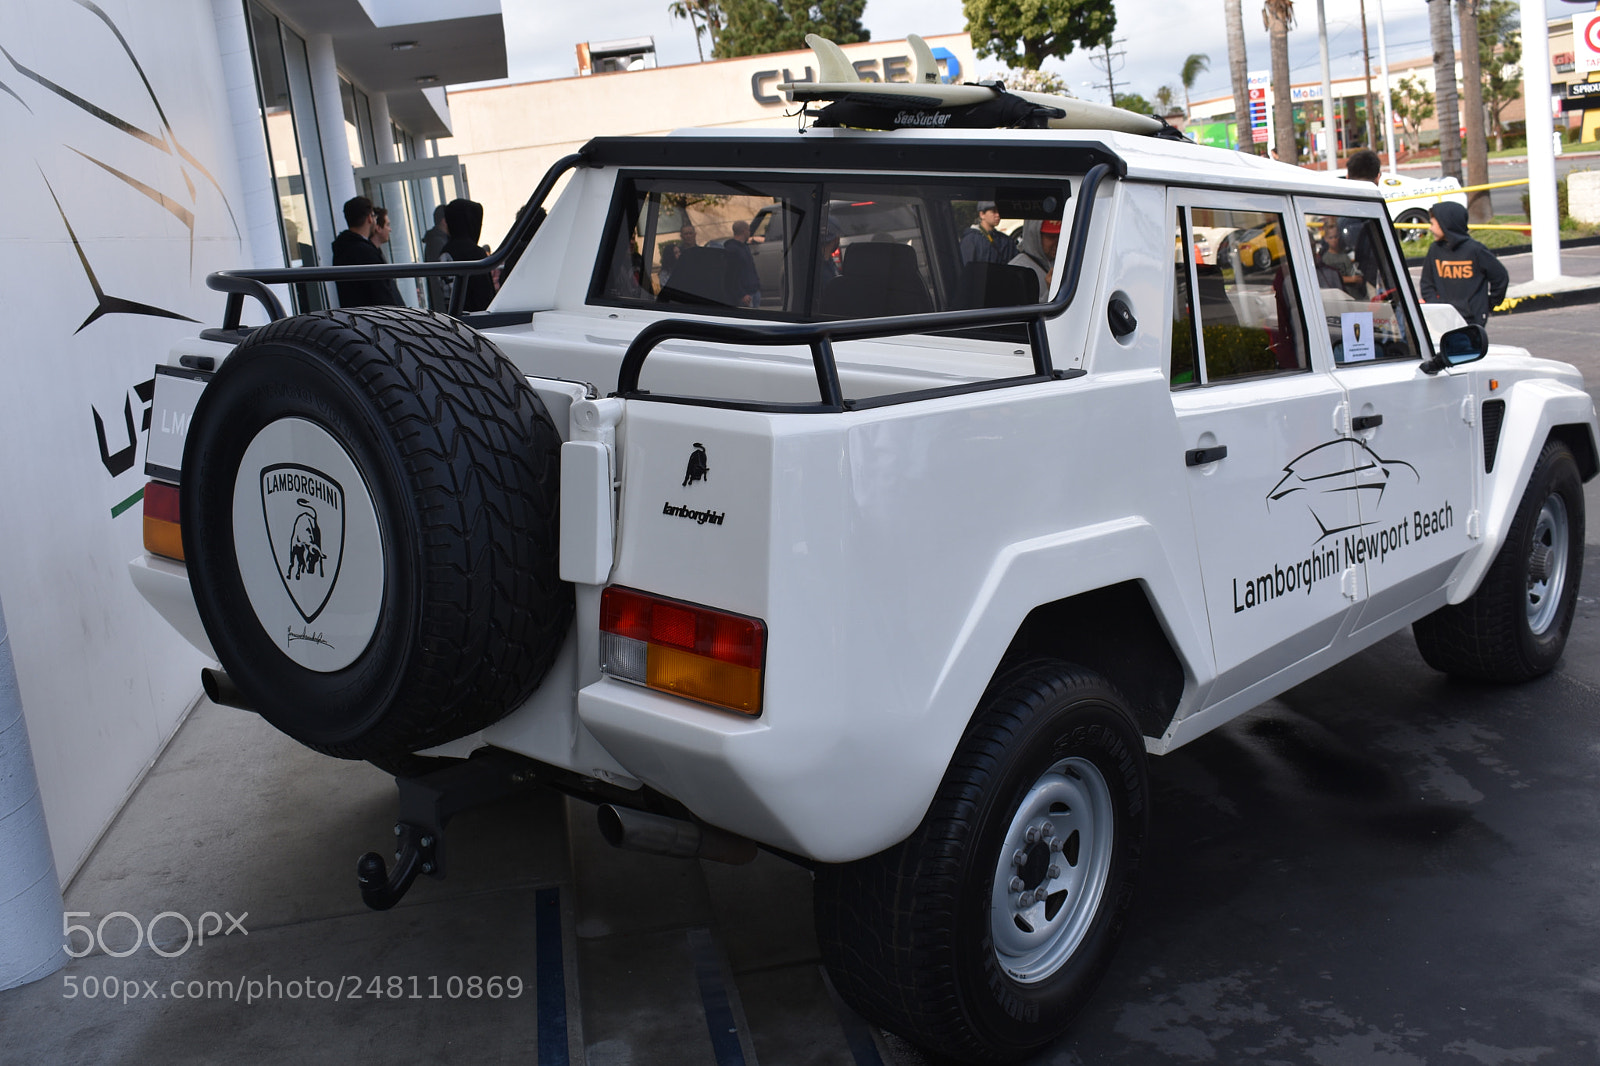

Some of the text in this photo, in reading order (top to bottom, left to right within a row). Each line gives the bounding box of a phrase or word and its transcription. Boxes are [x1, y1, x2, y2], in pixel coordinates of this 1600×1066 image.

[751, 55, 910, 105] CHSE
[1293, 87, 1323, 98] Mobil
[894, 110, 952, 126] SeaSucker
[1435, 259, 1474, 279] VANS
[266, 473, 338, 511] LAMBORGHINI
[663, 502, 725, 526] lamborghini
[1232, 499, 1454, 614] Lamborghini Newport Beach
